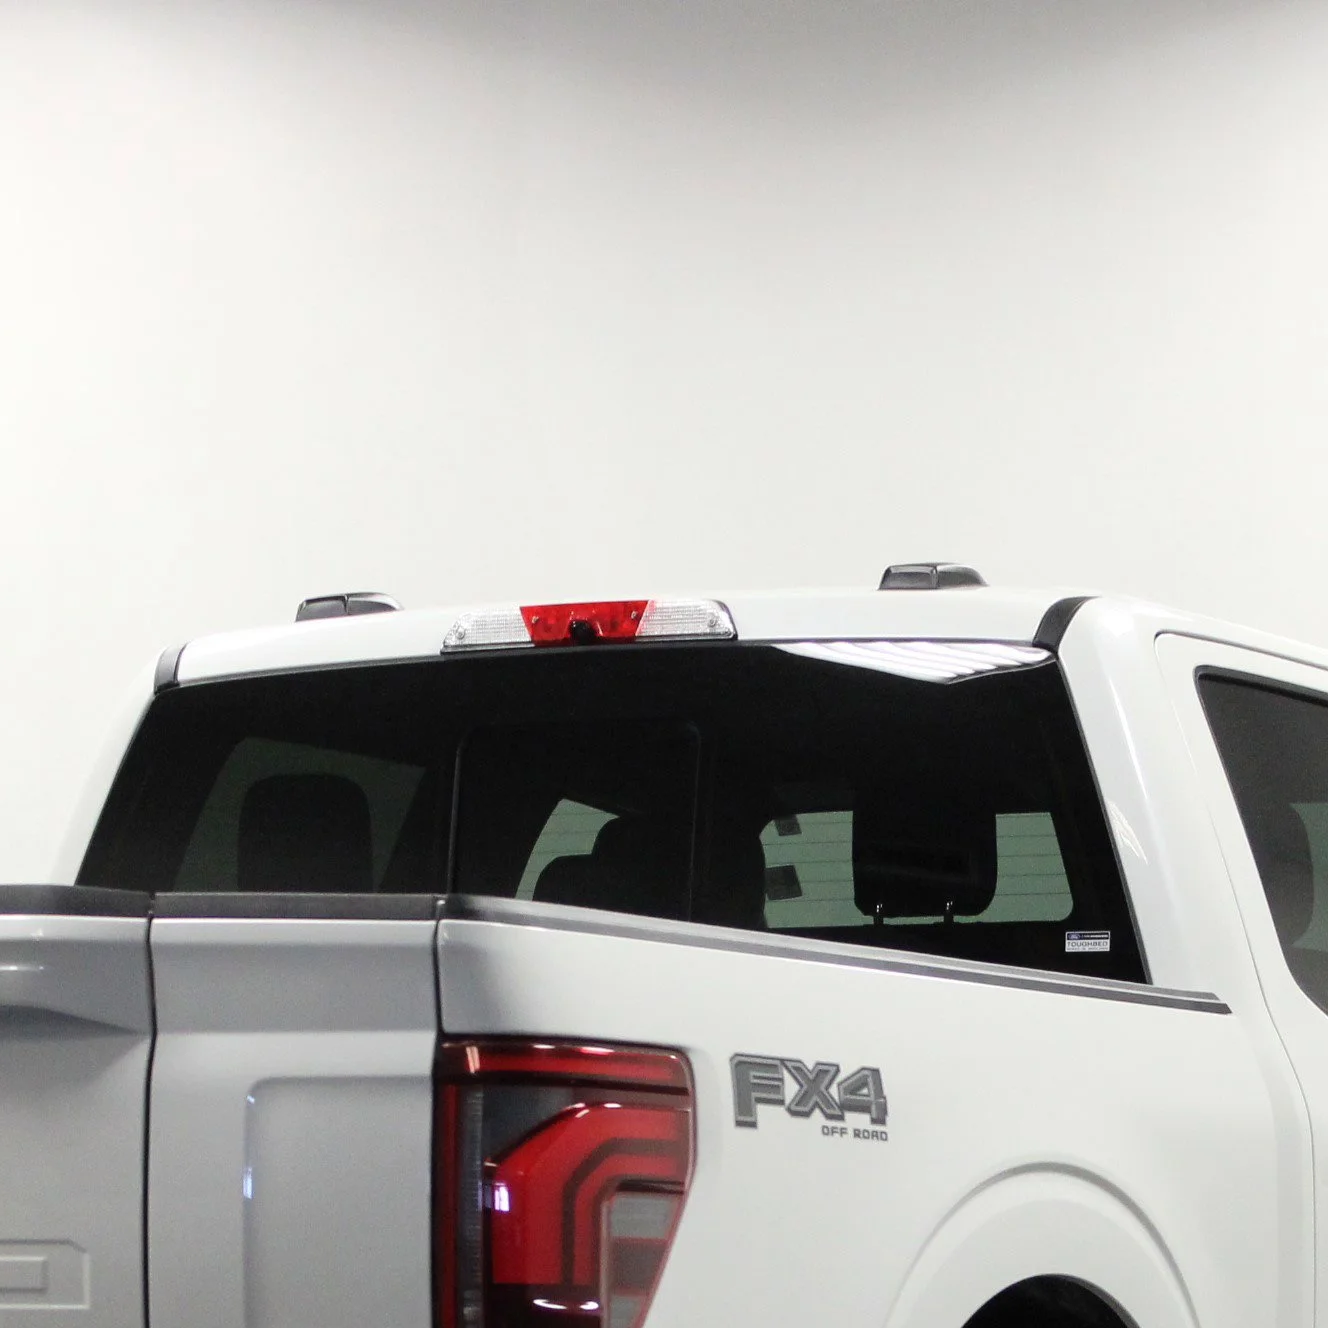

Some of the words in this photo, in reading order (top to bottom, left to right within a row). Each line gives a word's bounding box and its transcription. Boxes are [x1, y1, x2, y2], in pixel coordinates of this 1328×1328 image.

[729, 1053, 889, 1128] FX4
[821, 1125, 849, 1138] OFF
[853, 1128, 888, 1142] ROAD
